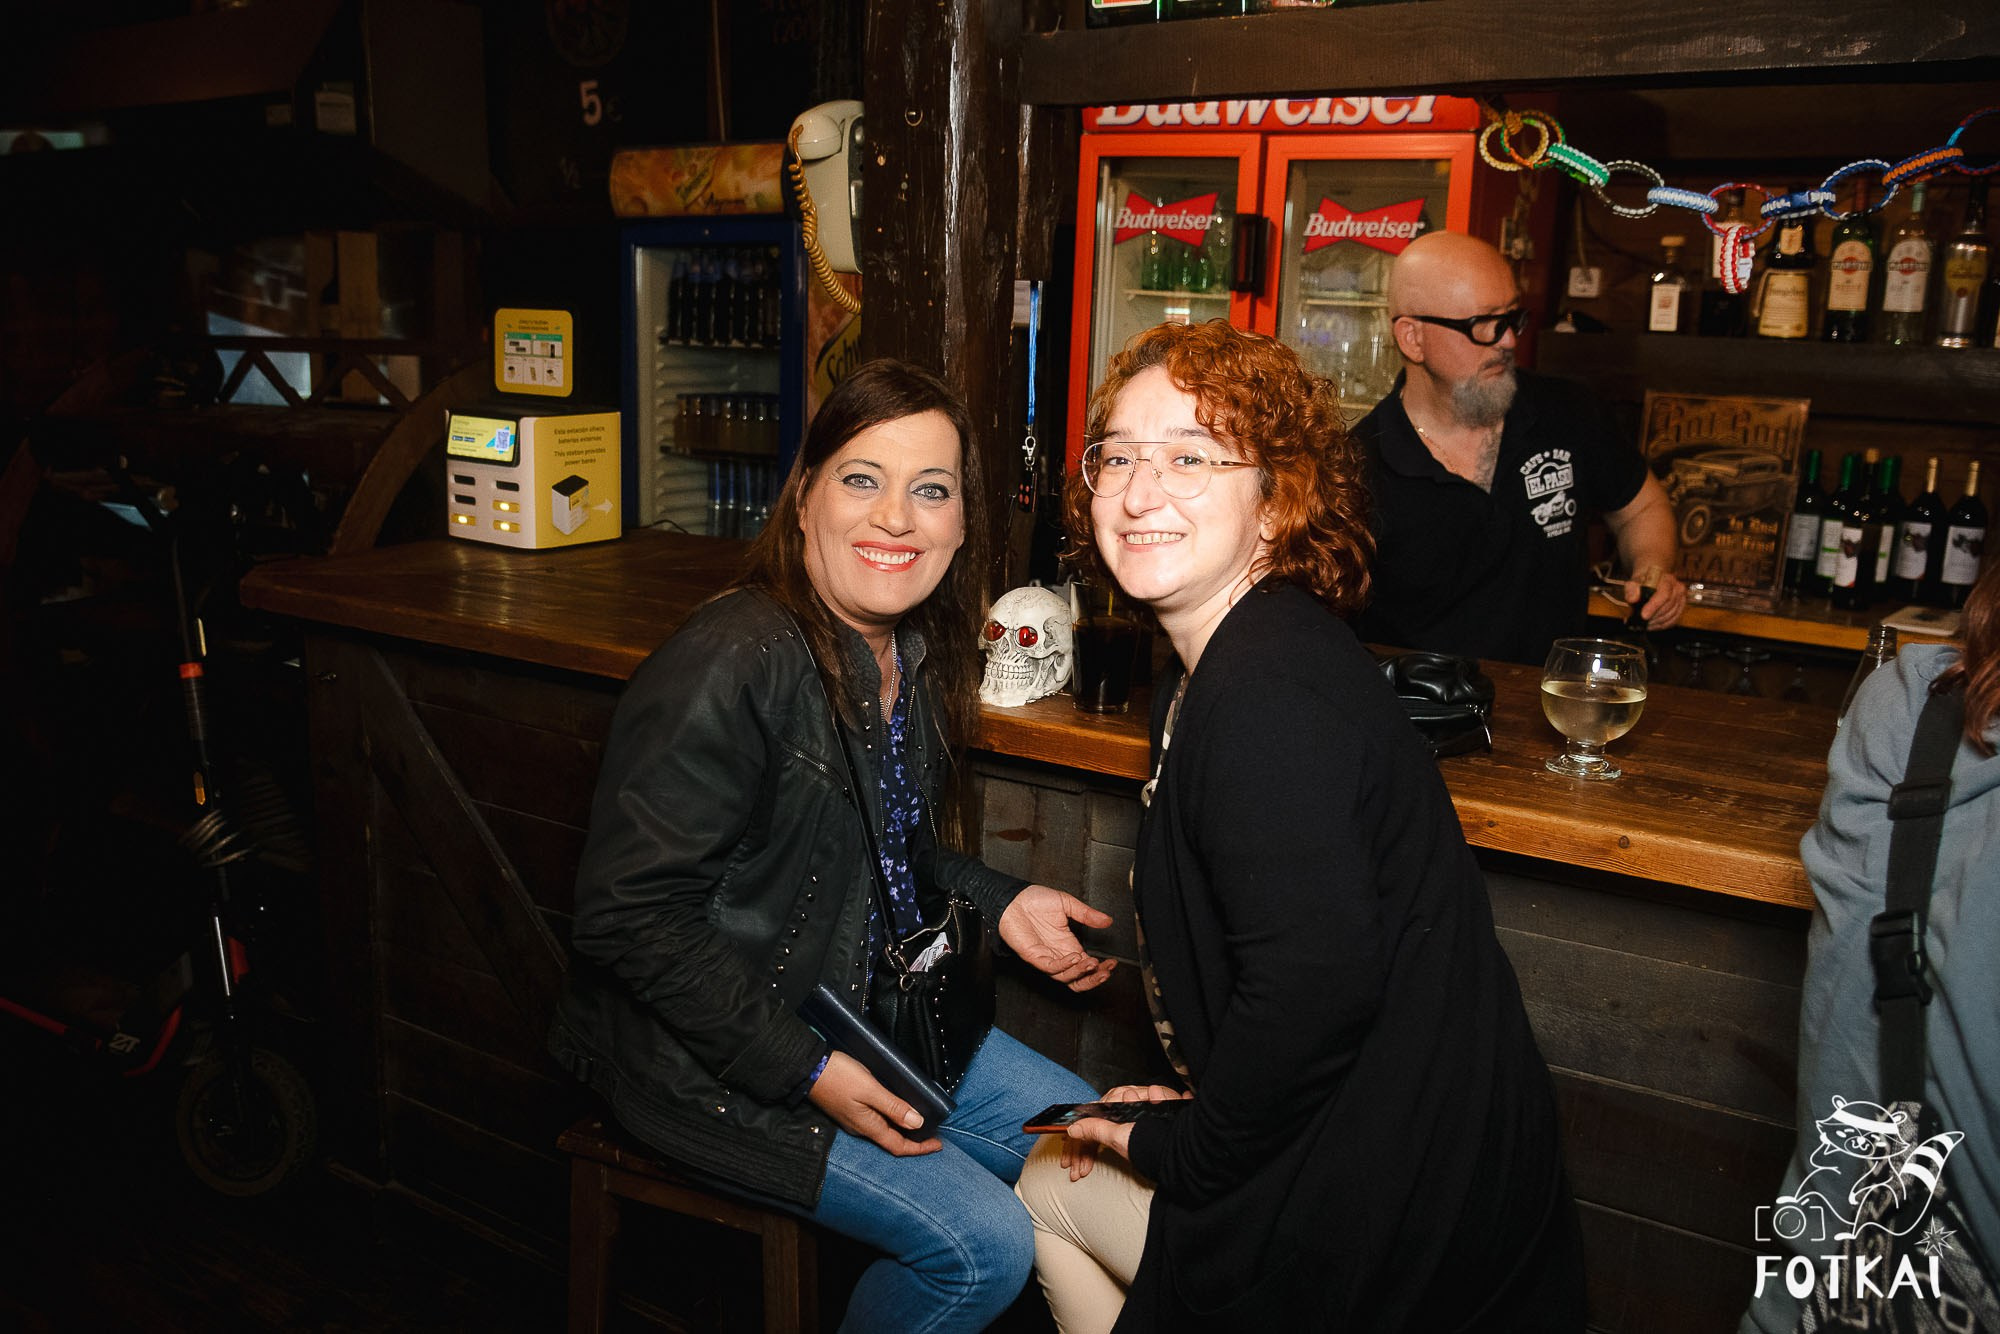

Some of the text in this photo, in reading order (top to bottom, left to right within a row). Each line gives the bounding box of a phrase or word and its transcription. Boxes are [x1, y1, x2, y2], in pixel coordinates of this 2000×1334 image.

[1096, 95, 1437, 126] weiser
[1114, 206, 1218, 231] Budweiser
[1303, 212, 1425, 240] Budweiser
[584, 447, 606, 456] provides
[564, 459, 581, 467] power
[1528, 477, 1545, 495] EL
